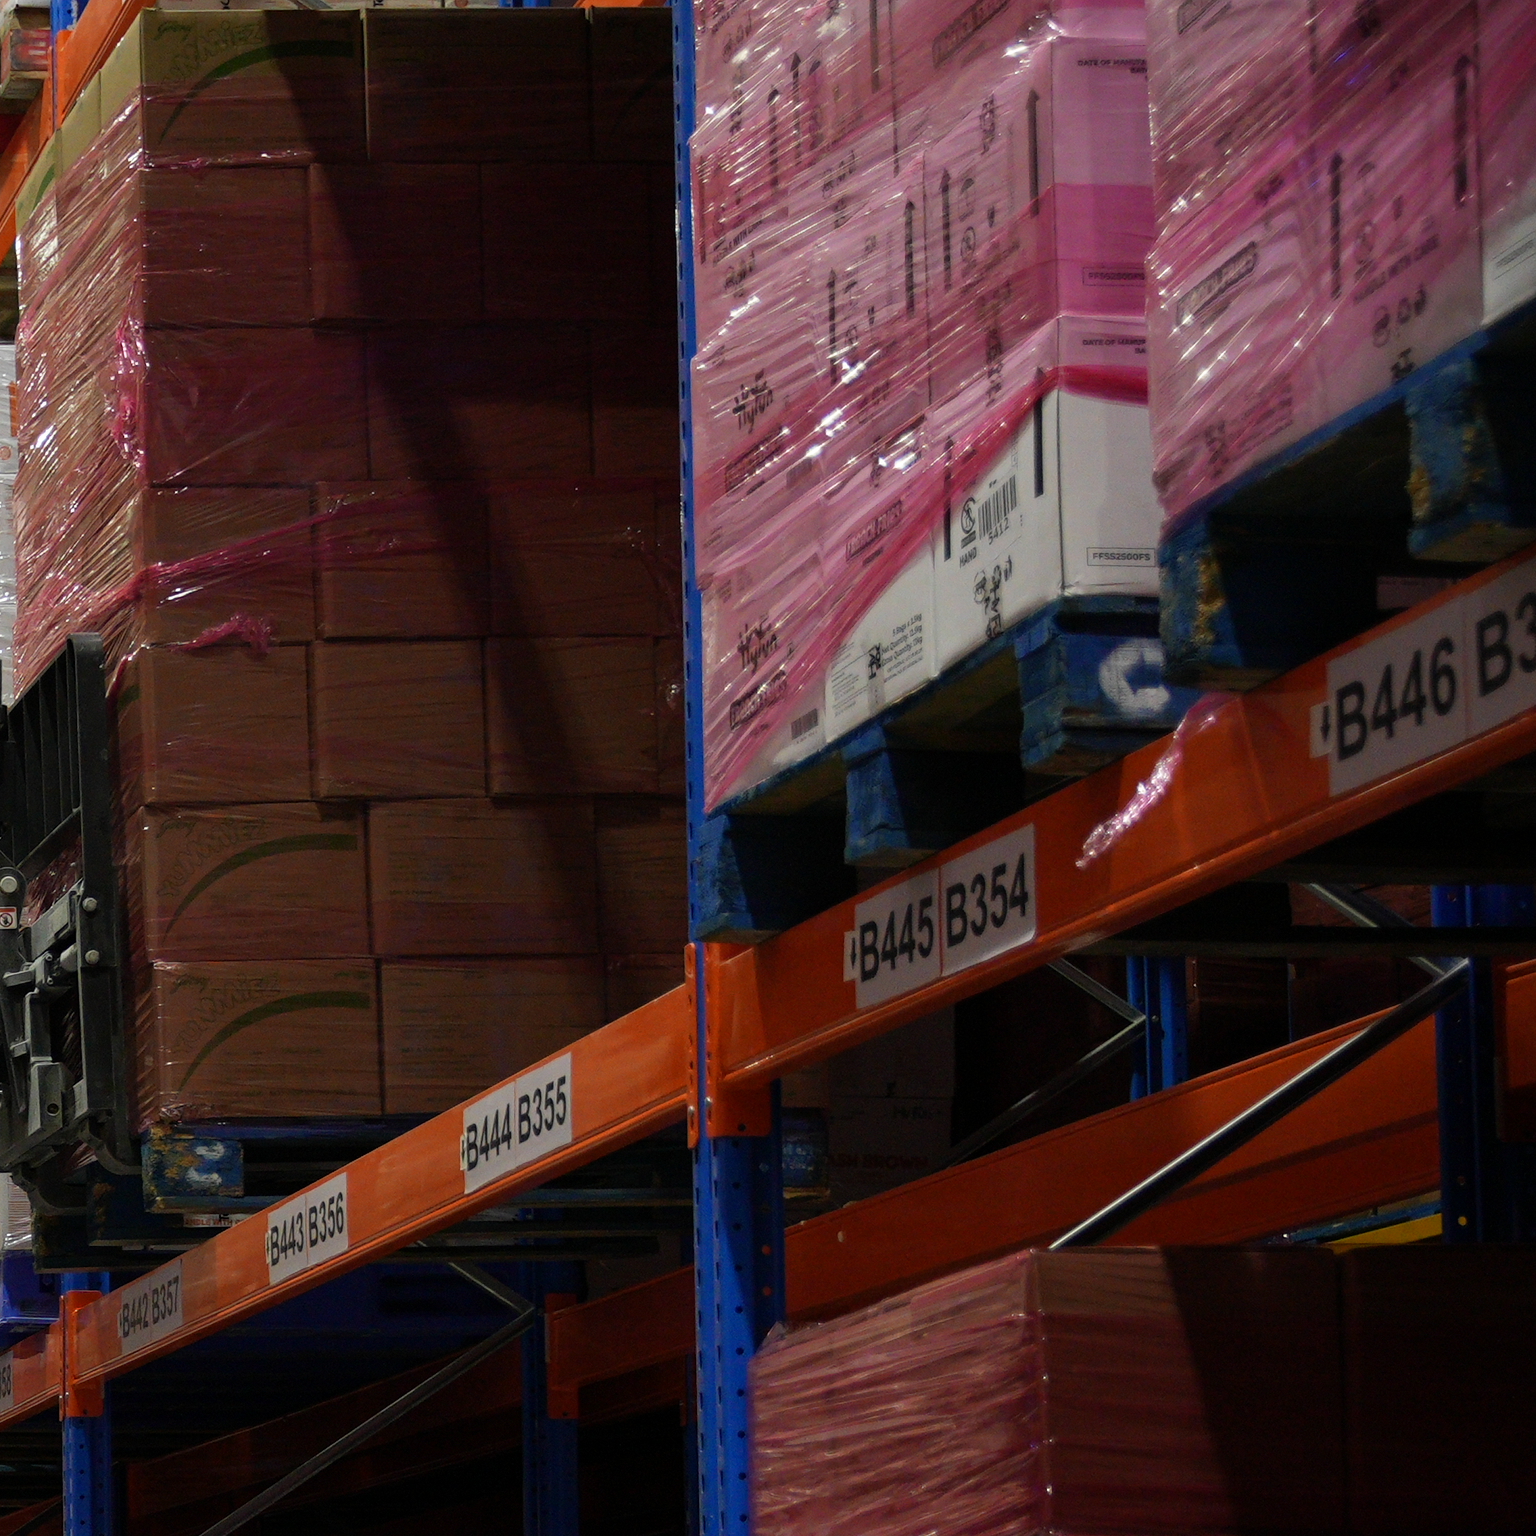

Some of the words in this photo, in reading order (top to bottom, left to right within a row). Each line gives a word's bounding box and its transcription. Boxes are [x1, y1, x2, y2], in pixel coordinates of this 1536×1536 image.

[959, 547, 977, 569] HAND
[988, 518, 1010, 545] 5412
[1336, 636, 1457, 764] B446
[859, 895, 934, 983] B445
[945, 852, 1029, 949] B354
[466, 1102, 512, 1172] B444
[518, 1074, 568, 1145] B355
[270, 1211, 304, 1267] B443
[308, 1191, 344, 1249] B356
[121, 1292, 149, 1339] B442
[151, 1275, 180, 1326] B357
